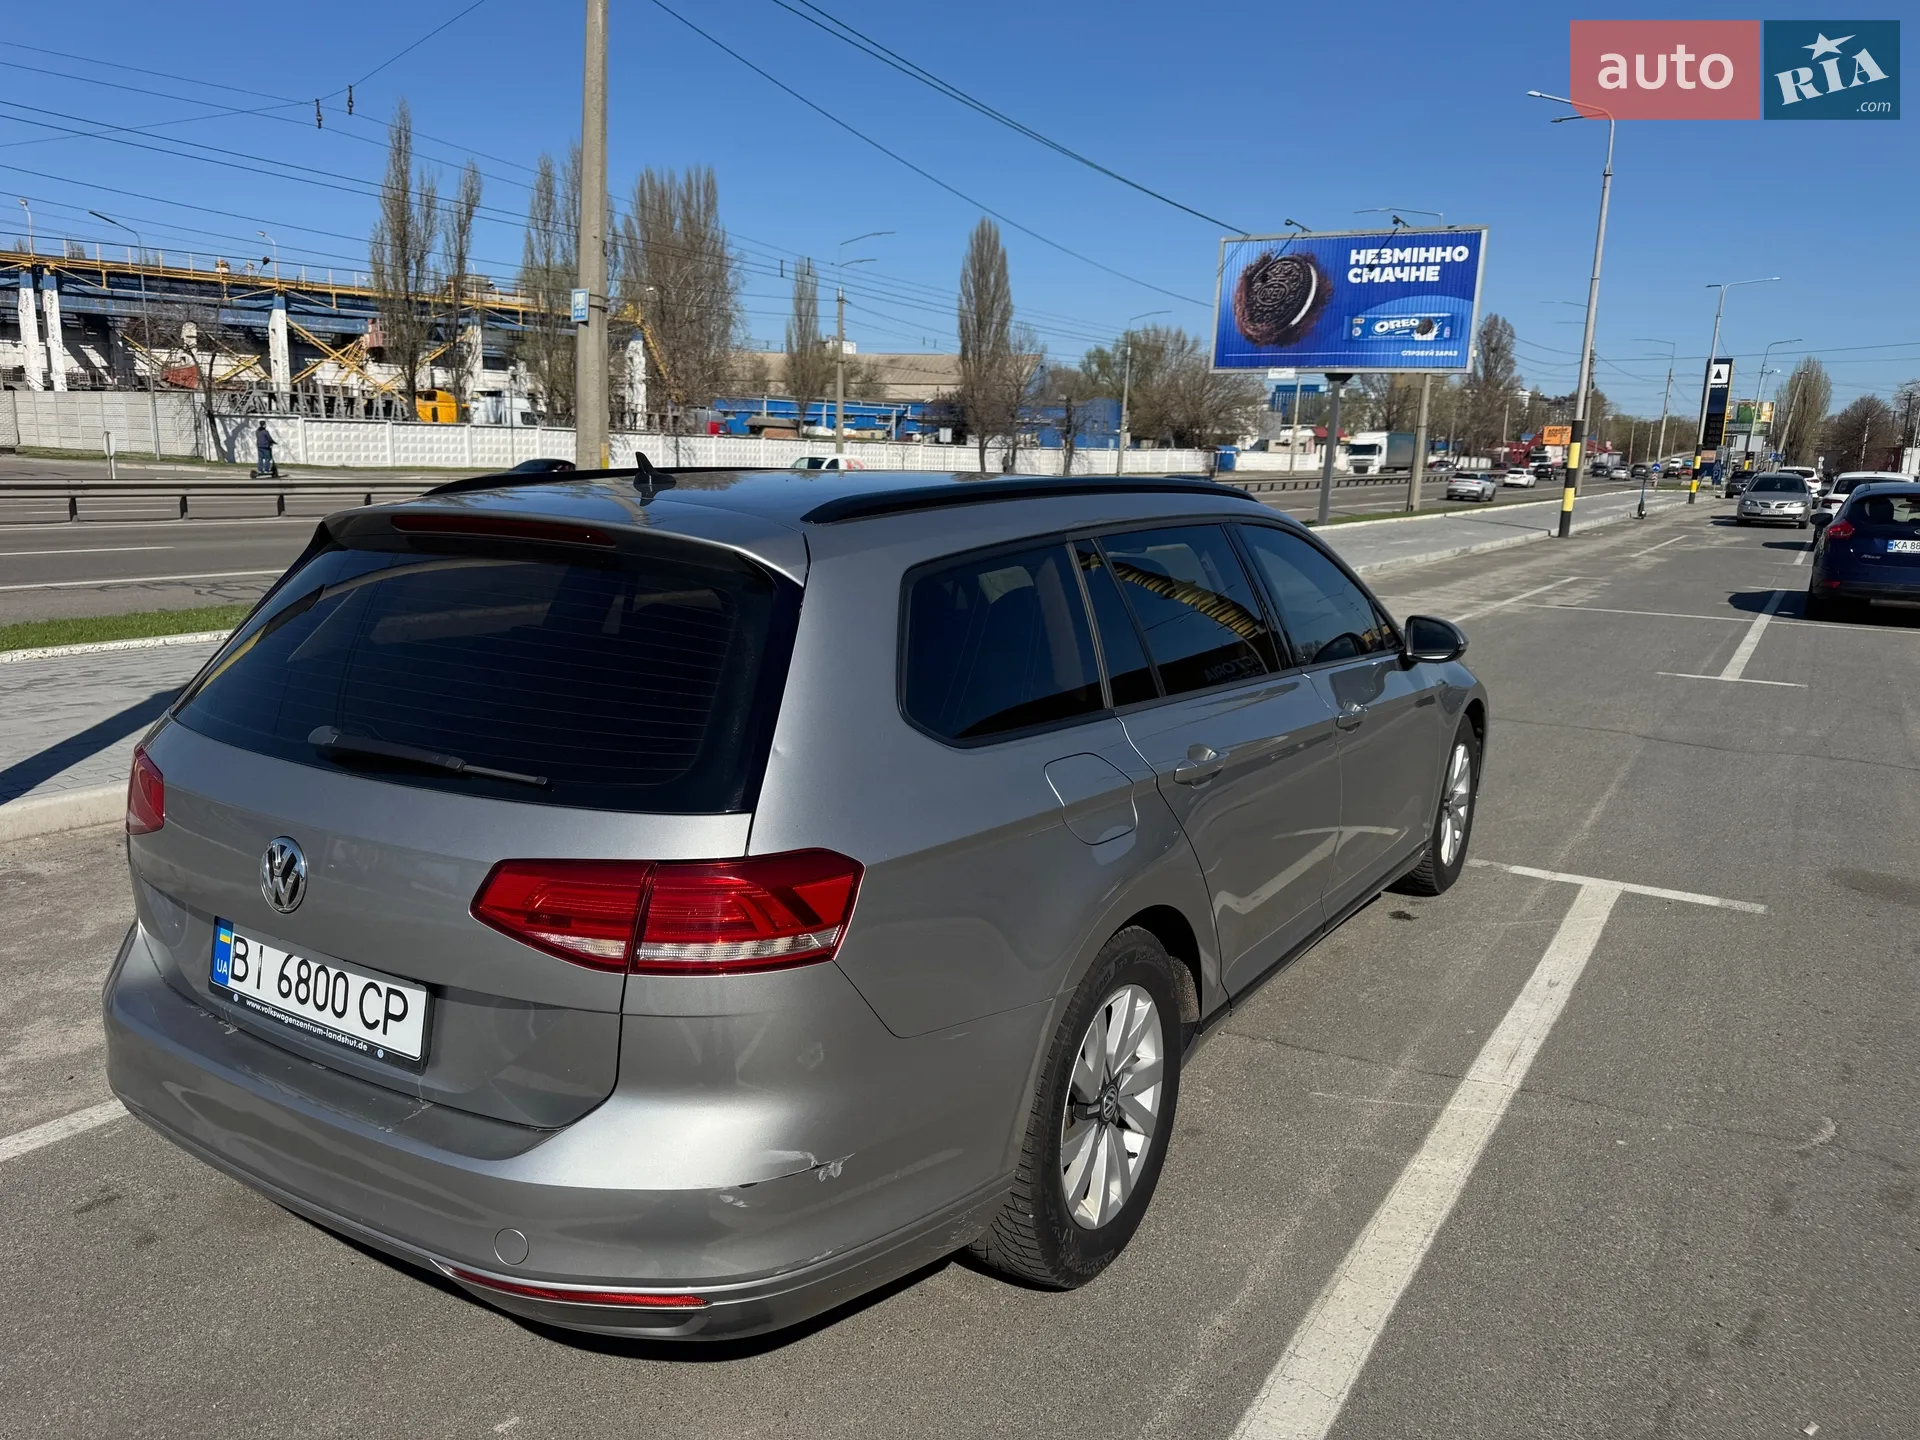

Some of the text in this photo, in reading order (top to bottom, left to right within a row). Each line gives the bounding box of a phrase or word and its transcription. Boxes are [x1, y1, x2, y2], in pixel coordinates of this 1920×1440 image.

[1349, 245, 1469, 265] НЕЗМІННО
[1347, 265, 1440, 284] СМАЧНЕ
[1260, 287, 1285, 299] OREO
[1375, 318, 1420, 333] OREO
[217, 958, 228, 976] UA
[277, 954, 350, 1019] 6800
[358, 981, 409, 1036] CP
[246, 999, 368, 1051] www.volkswagenzentrum-landshut.de
